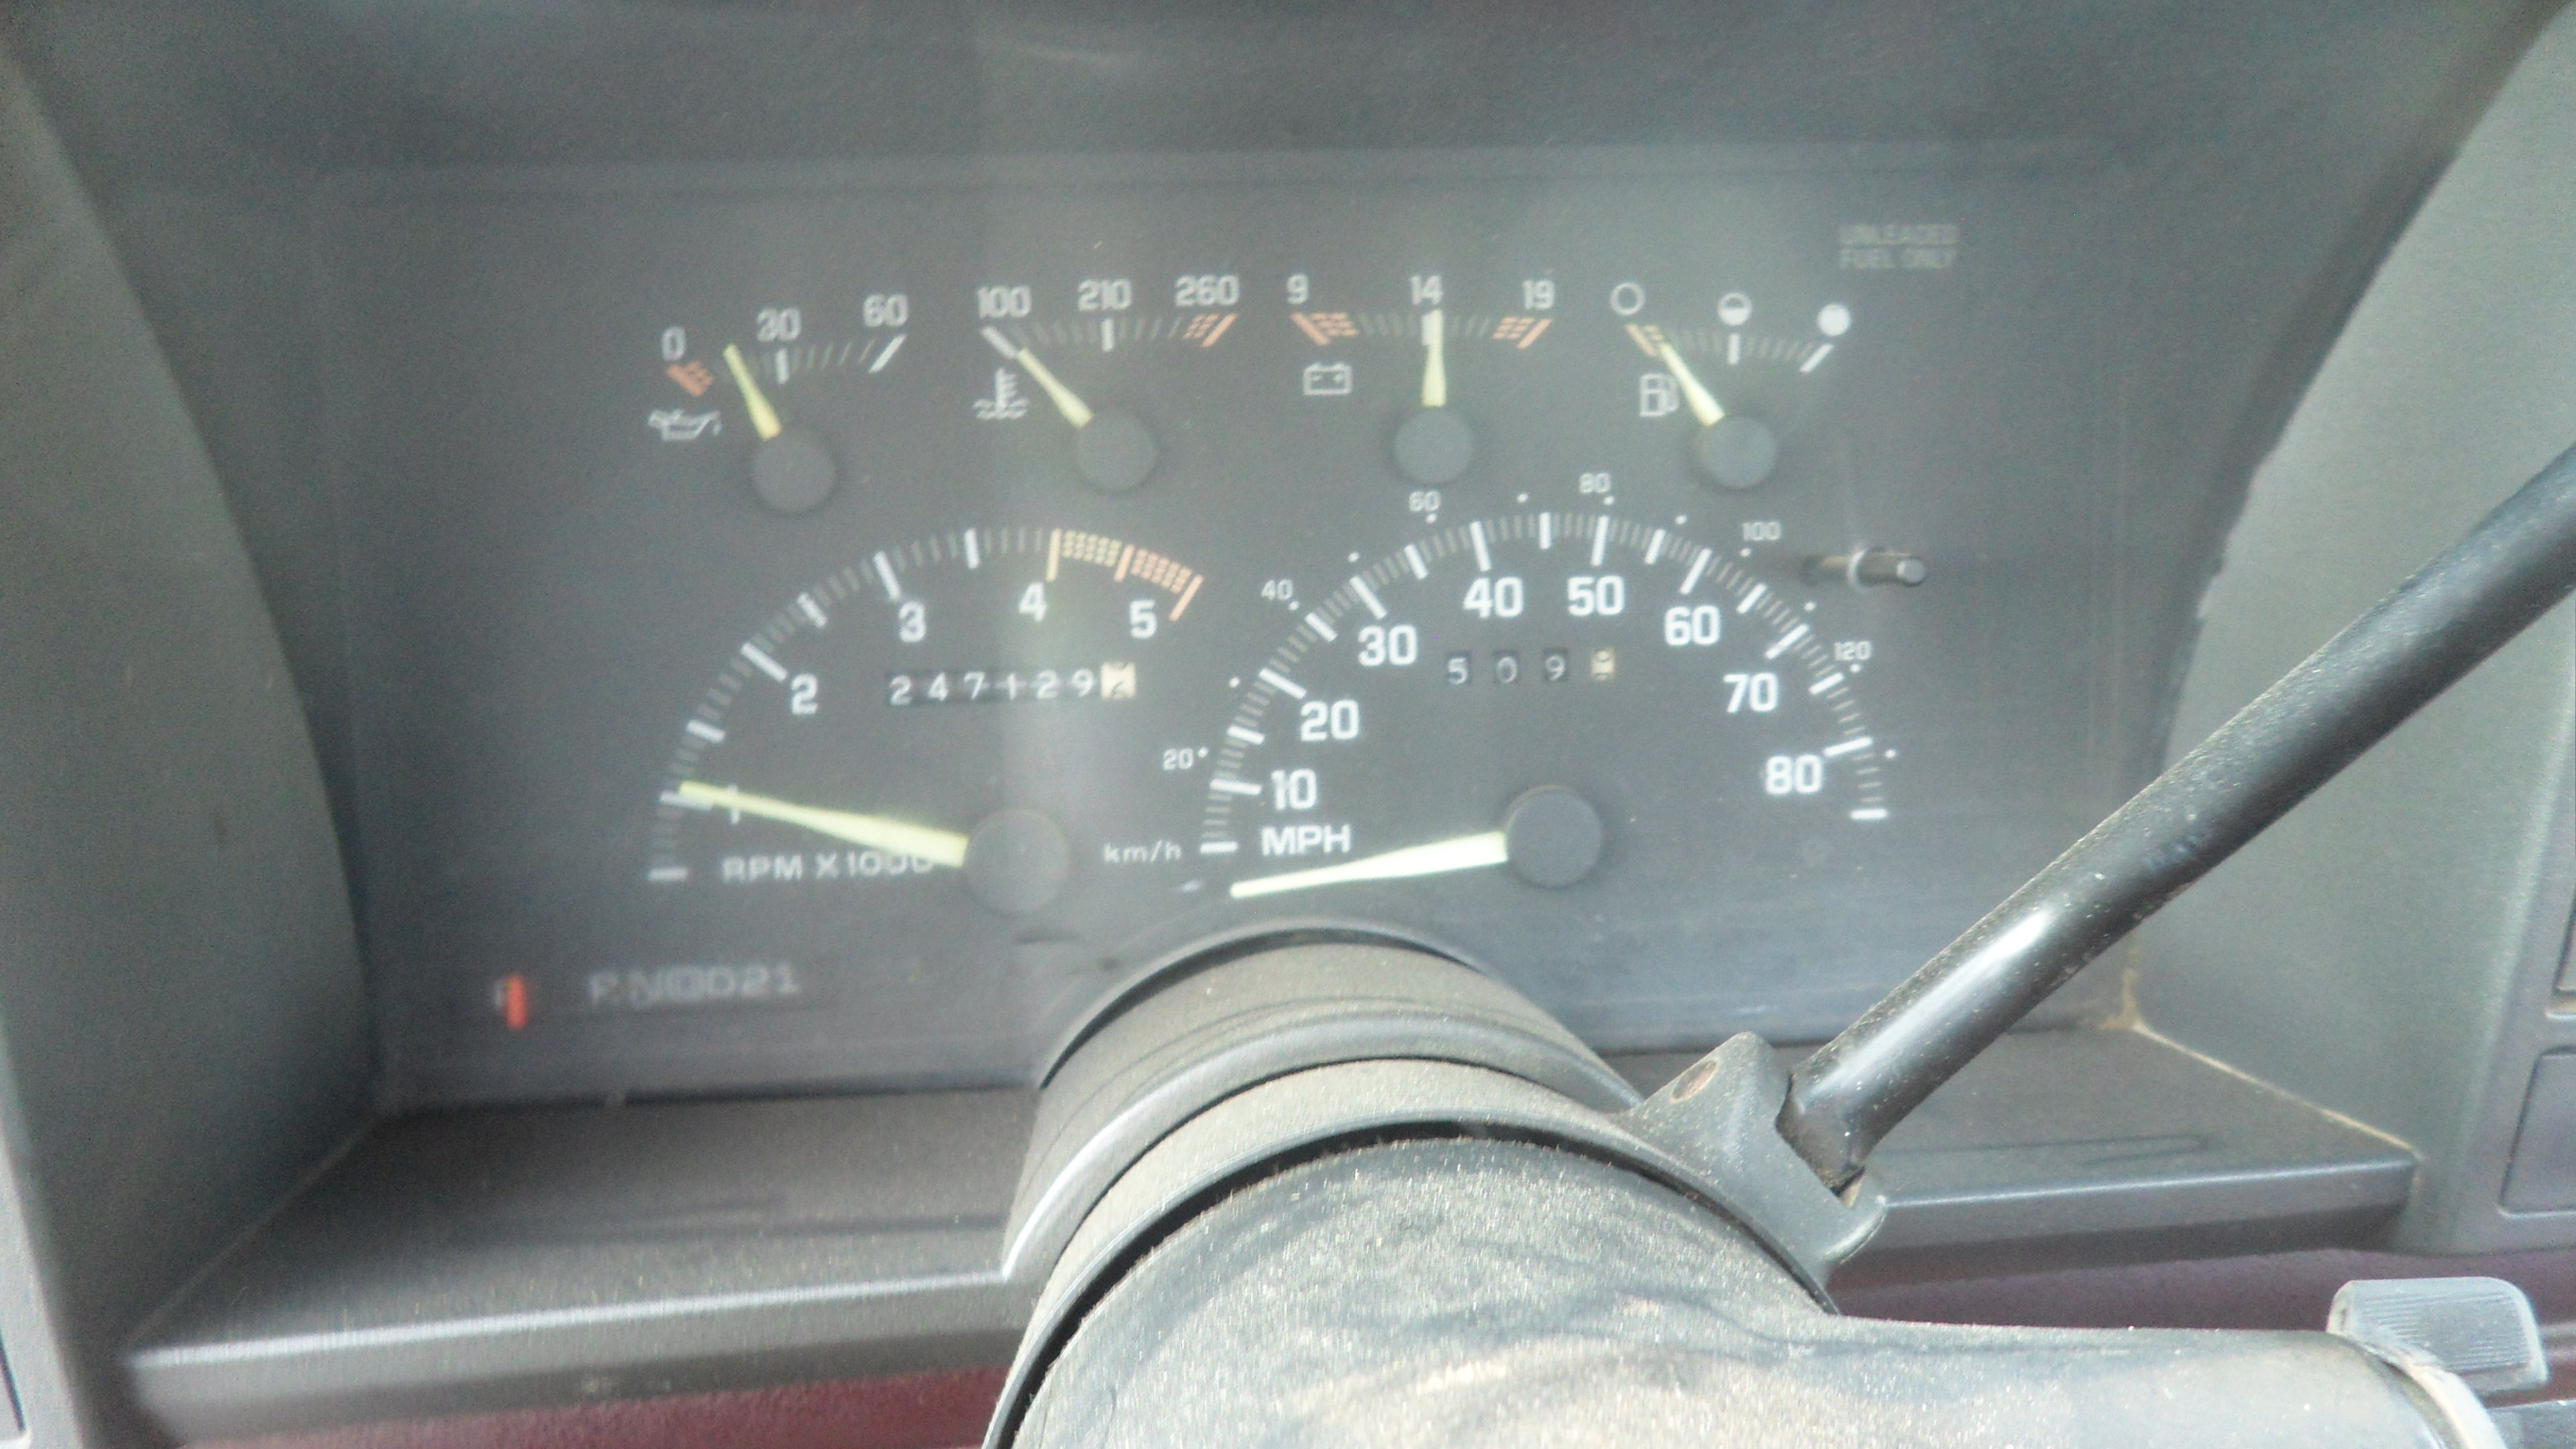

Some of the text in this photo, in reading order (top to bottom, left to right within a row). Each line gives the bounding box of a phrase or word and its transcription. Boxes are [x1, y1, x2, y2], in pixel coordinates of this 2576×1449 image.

[977, 275, 1239, 318] 100 210 260
[1287, 274, 1554, 310] 9 14 19
[661, 294, 908, 360] 0 30 60
[1409, 490, 1441, 513] 60
[1579, 472, 1611, 494] 80
[1742, 521, 1781, 542] 100
[1019, 582, 1048, 622] 4
[1261, 579, 1293, 600] 40
[1463, 576, 1523, 618] 40
[1568, 575, 1624, 616] 50
[899, 601, 926, 642] 3
[1130, 600, 1157, 639] 5
[1664, 604, 1720, 646] 60
[1358, 625, 1417, 667] 30
[1834, 640, 1872, 661] 120
[792, 674, 818, 714] 2
[1723, 672, 1778, 713] 70
[1301, 699, 1359, 741] 20
[1163, 748, 1194, 770] 20
[1766, 754, 1823, 795] 80
[1271, 769, 1318, 810] 10
[1103, 840, 1181, 863] km/h
[1261, 824, 1350, 855] MPH
[723, 855, 804, 879] RPM
